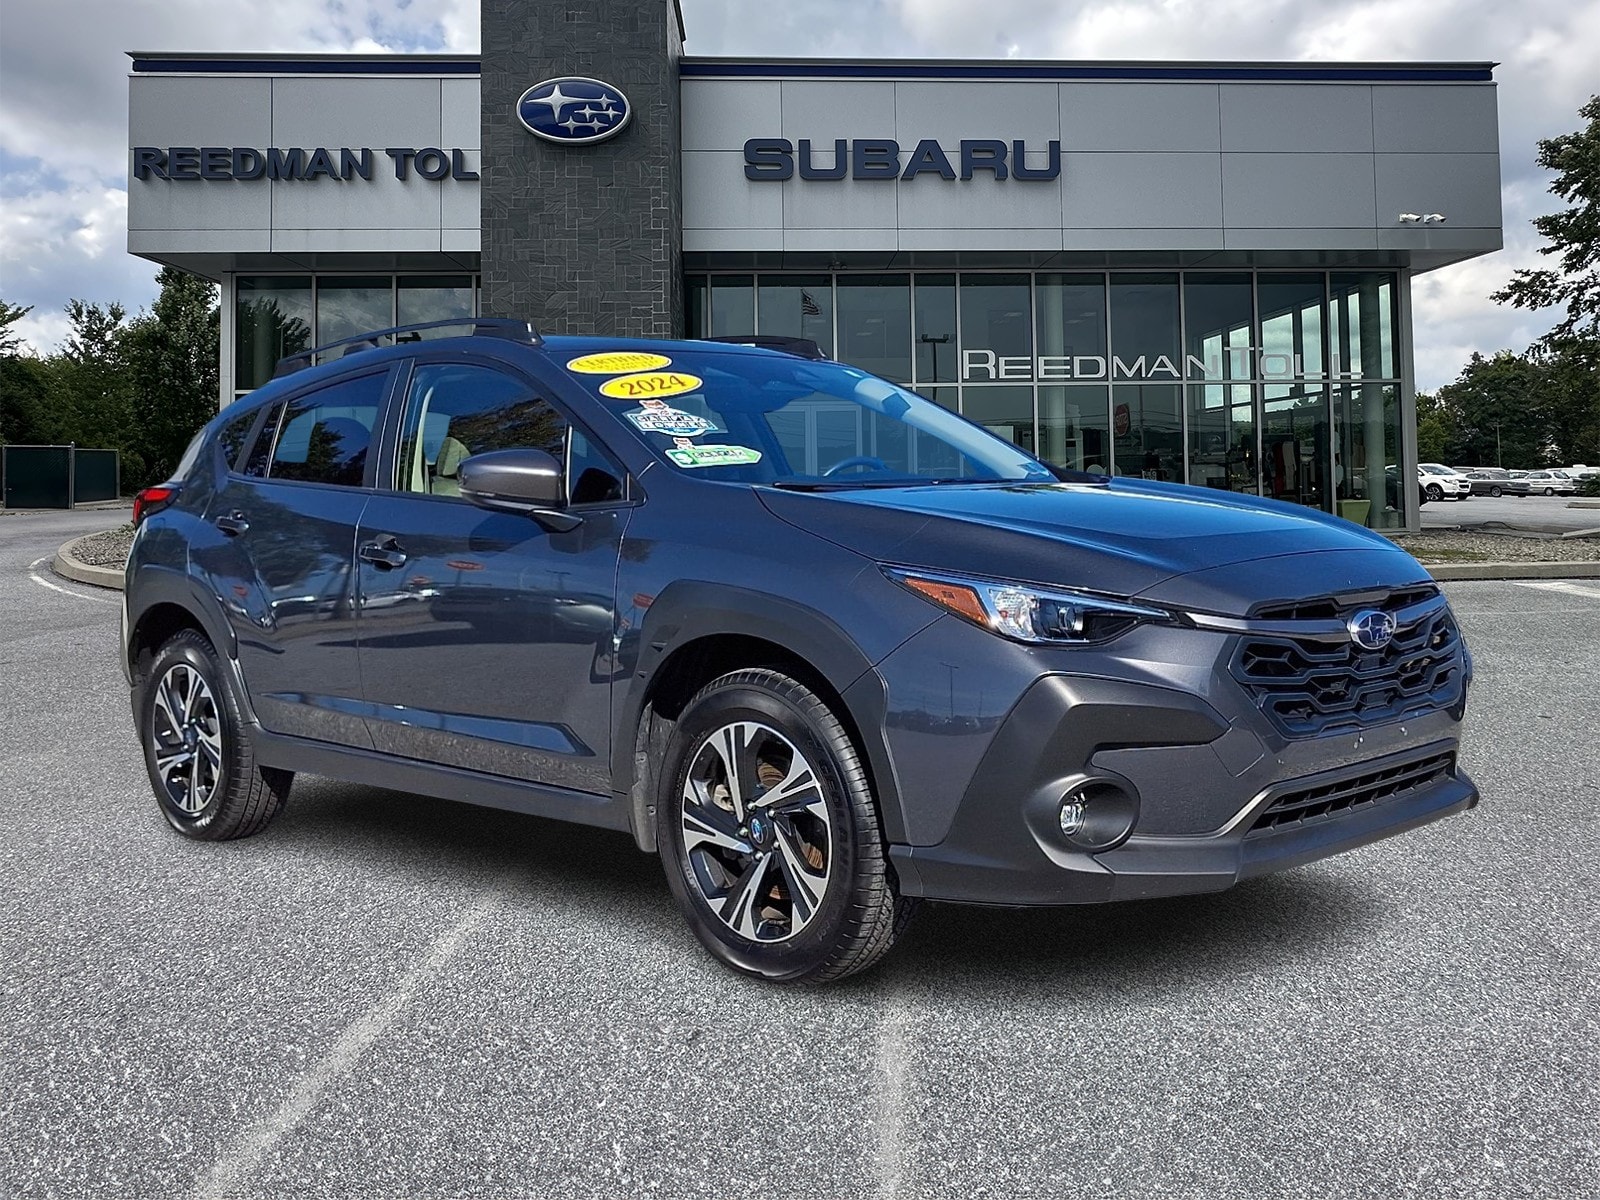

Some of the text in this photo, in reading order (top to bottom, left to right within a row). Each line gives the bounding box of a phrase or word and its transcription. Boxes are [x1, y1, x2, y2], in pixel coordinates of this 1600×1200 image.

[133, 147, 372, 181] REEDMAN
[743, 138, 1061, 181] SUBARU
[619, 374, 687, 396] 2024
